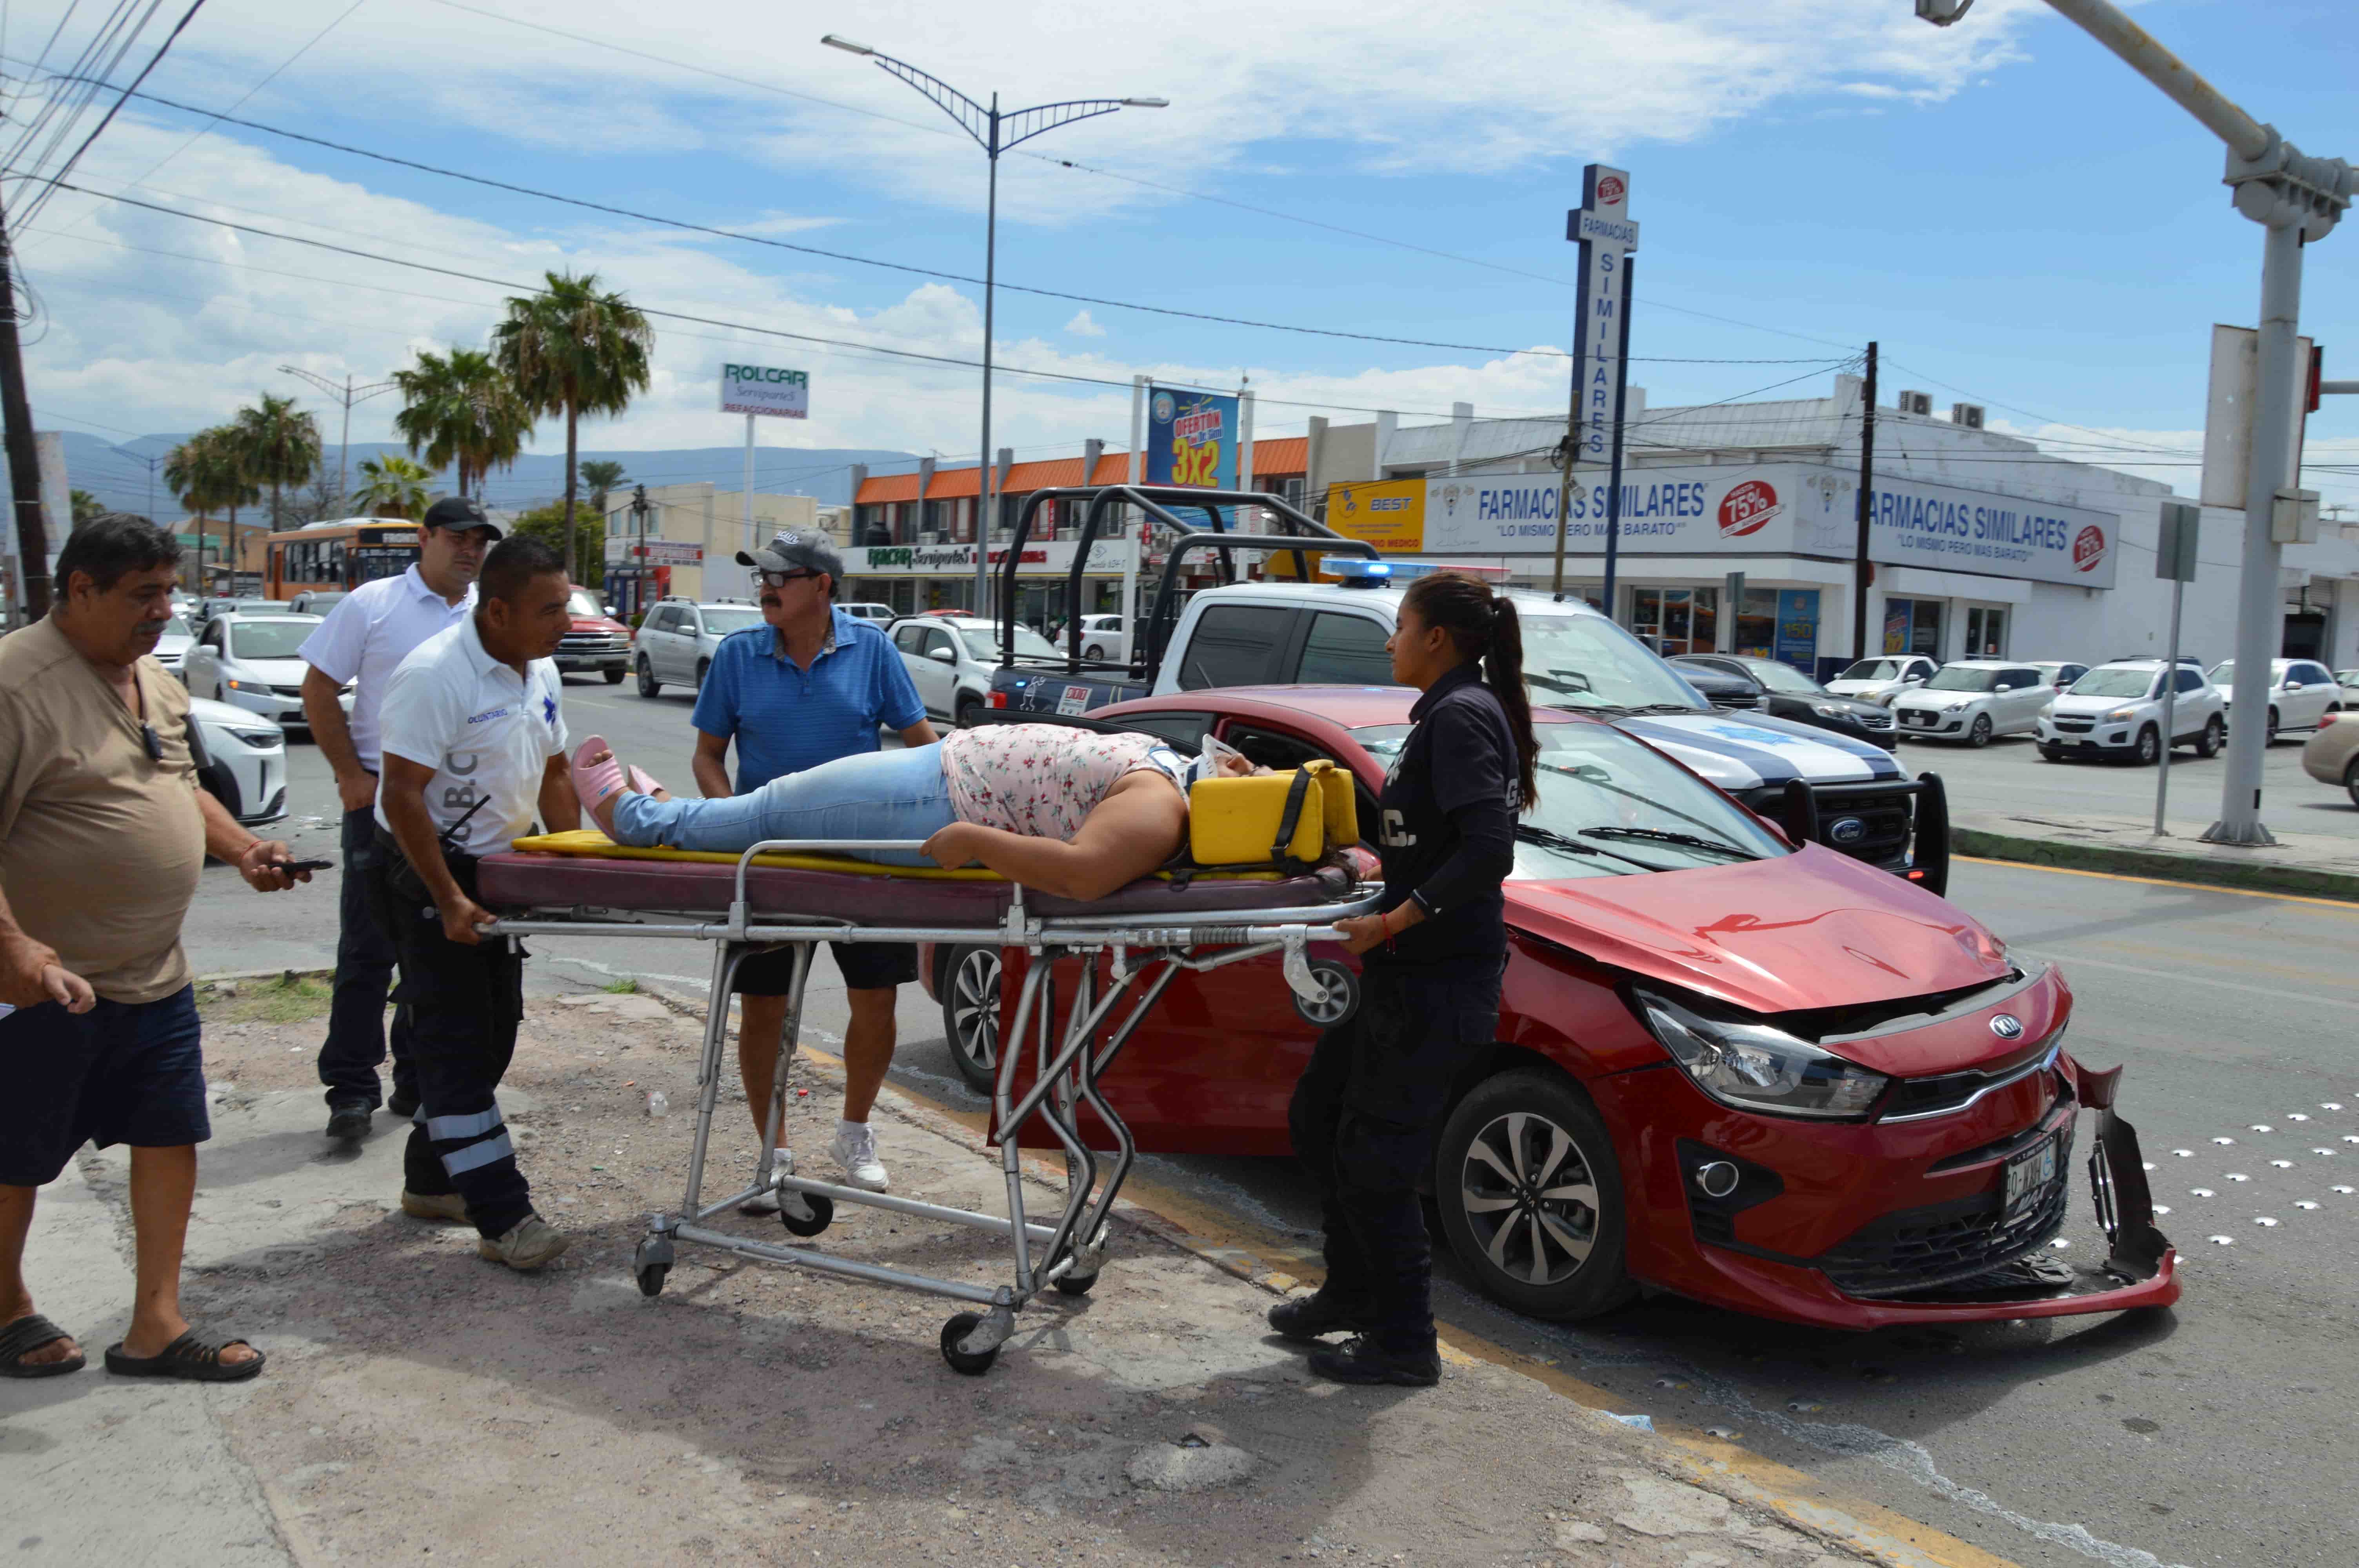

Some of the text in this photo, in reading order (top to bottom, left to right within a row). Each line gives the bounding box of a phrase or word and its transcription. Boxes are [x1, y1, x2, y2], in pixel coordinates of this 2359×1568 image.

[1584, 218, 1634, 243] FARMACIAS
[1590, 253, 1614, 453] SIMILARES
[726, 364, 807, 390] ROLCAR
[724, 403, 805, 419] REFACCIONARIAS
[1370, 497, 1413, 511] BEST
[1725, 488, 1767, 522] 75%
[1518, 524, 1556, 536] MISMO
[1567, 523, 1591, 535] ERO
[1975, 506, 2067, 550] SIMILARES
[1387, 539, 1419, 548] MEDICO
[1916, 537, 1945, 552] MISMO
[1946, 540, 1972, 555] PERO
[1782, 623, 1813, 639] 150
[1067, 688, 1087, 701] 911
[1841, 824, 1858, 838] Ford
[1995, 1017, 2020, 1034] KIA
[1521, 1189, 1535, 1208] KIA
